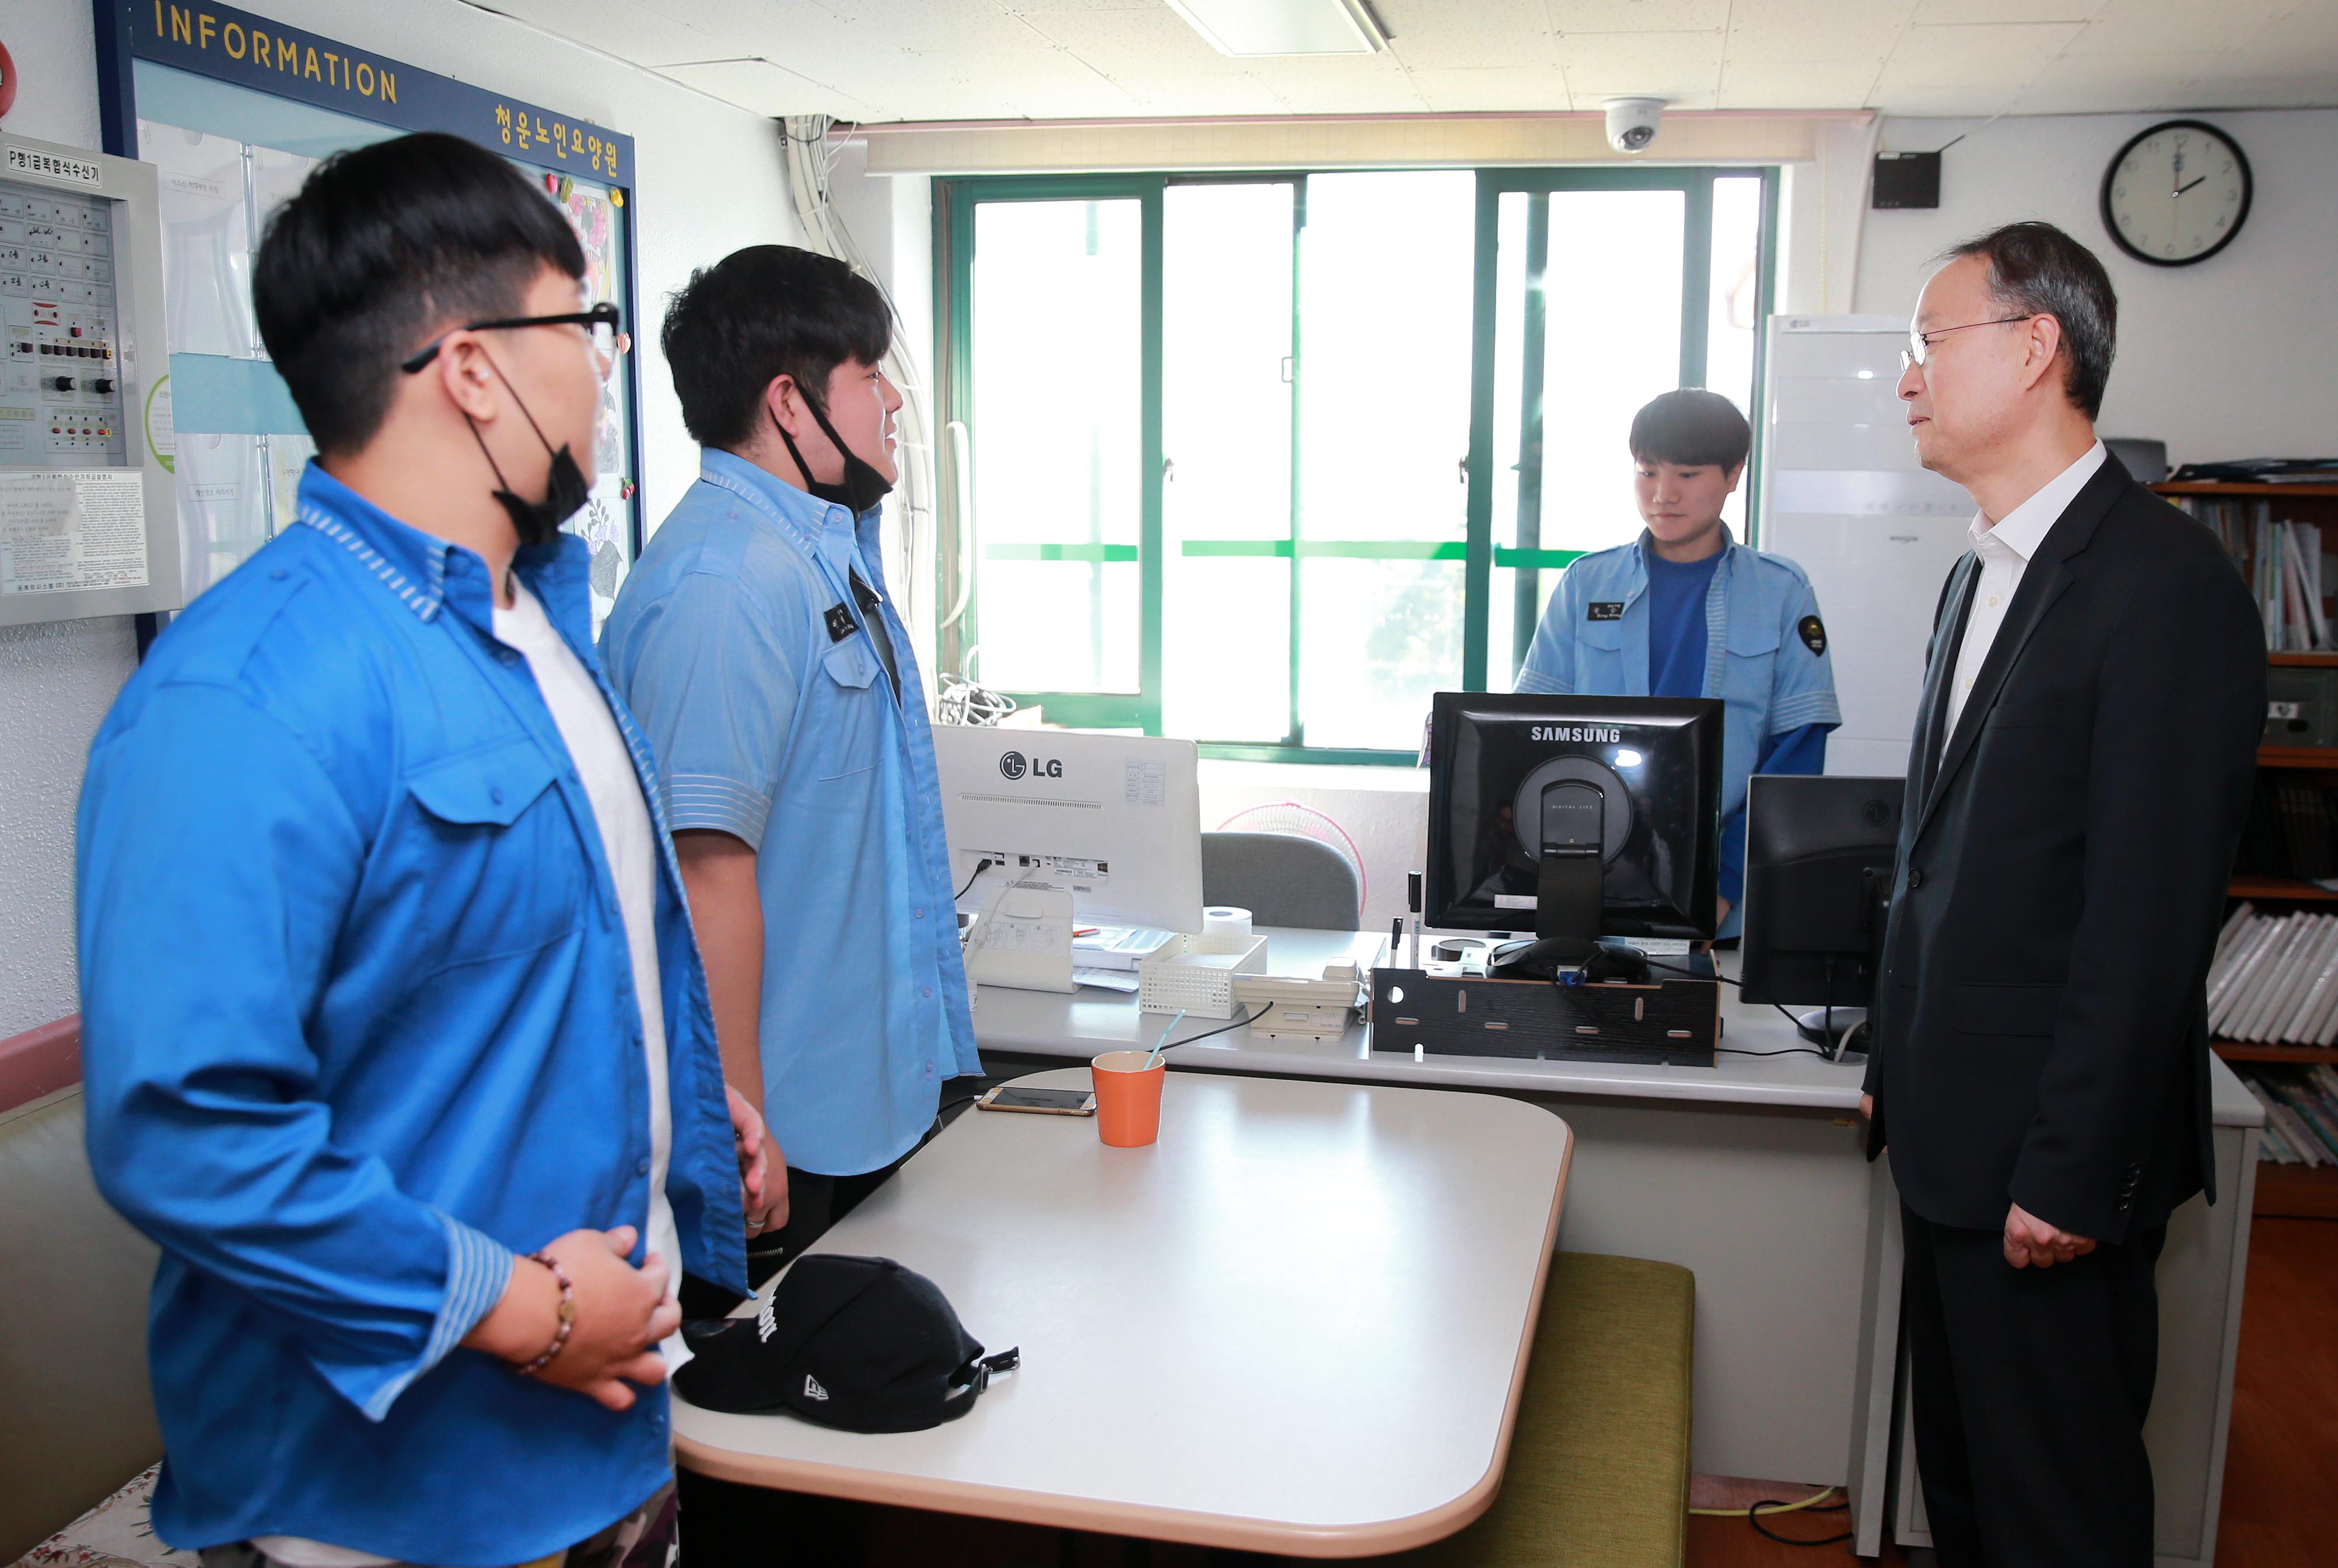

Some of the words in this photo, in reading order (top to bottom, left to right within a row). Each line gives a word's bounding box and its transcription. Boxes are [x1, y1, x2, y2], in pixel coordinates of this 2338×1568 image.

[155, 0, 397, 104] INFORMATION
[495, 104, 617, 177] 청운노인요양원
[1531, 726, 1620, 743] SAMSUNG
[1033, 758, 1062, 778] LG
